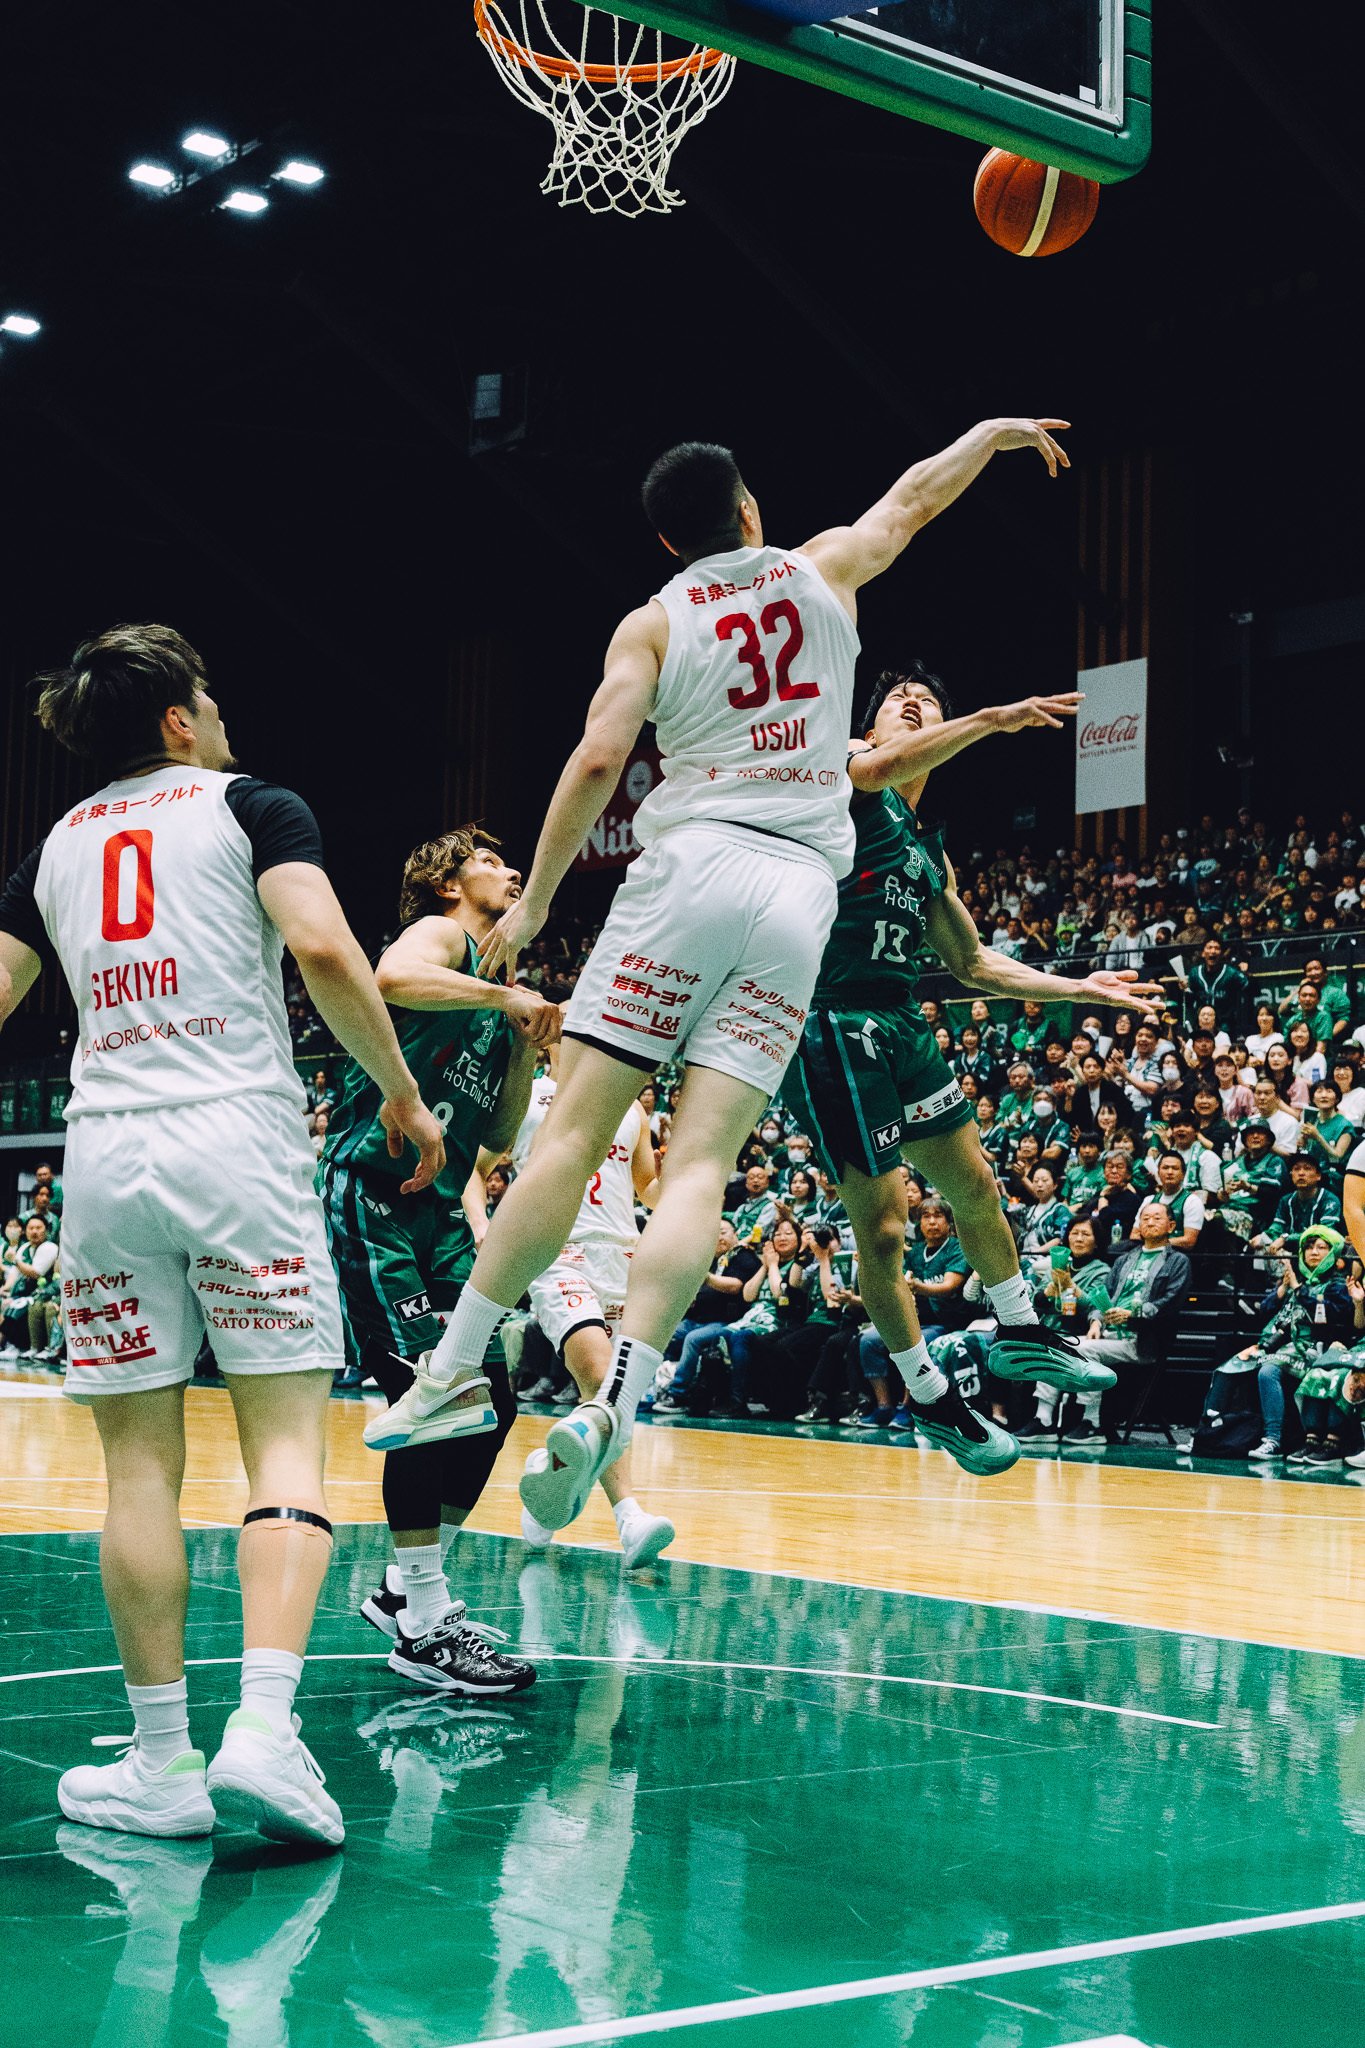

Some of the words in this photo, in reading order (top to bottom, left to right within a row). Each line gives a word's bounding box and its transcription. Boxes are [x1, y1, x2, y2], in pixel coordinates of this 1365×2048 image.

[687, 561, 797, 605] 岩泉ヨーグルト
[715, 599, 820, 710] 32
[751, 718, 807, 751] USUI
[1080, 713, 1139, 749] Coca-Cola
[818, 773, 838, 787] CITY
[68, 783, 204, 828] 岩泉ヨーグルト
[102, 829, 155, 942] 0
[871, 920, 910, 963] 13
[91, 957, 179, 1012] SEKIYA
[620, 953, 702, 985] 岩手トヨペット
[607, 996, 650, 1017] TOYOTA
[612, 974, 692, 1008] 岩手トヨタ
[93, 1021, 180, 1052] MORIOKA
[185, 1017, 228, 1037] CITY
[730, 1028, 759, 1047] SATO
[932, 1085, 964, 1115] 三菱地
[877, 1122, 902, 1147] KA
[197, 1256, 306, 1278] ネッツトヨタ岩手
[107, 1325, 151, 1354] L&F
[212, 1316, 250, 1330] SATO
[253, 1316, 314, 1330] KOUSAN
